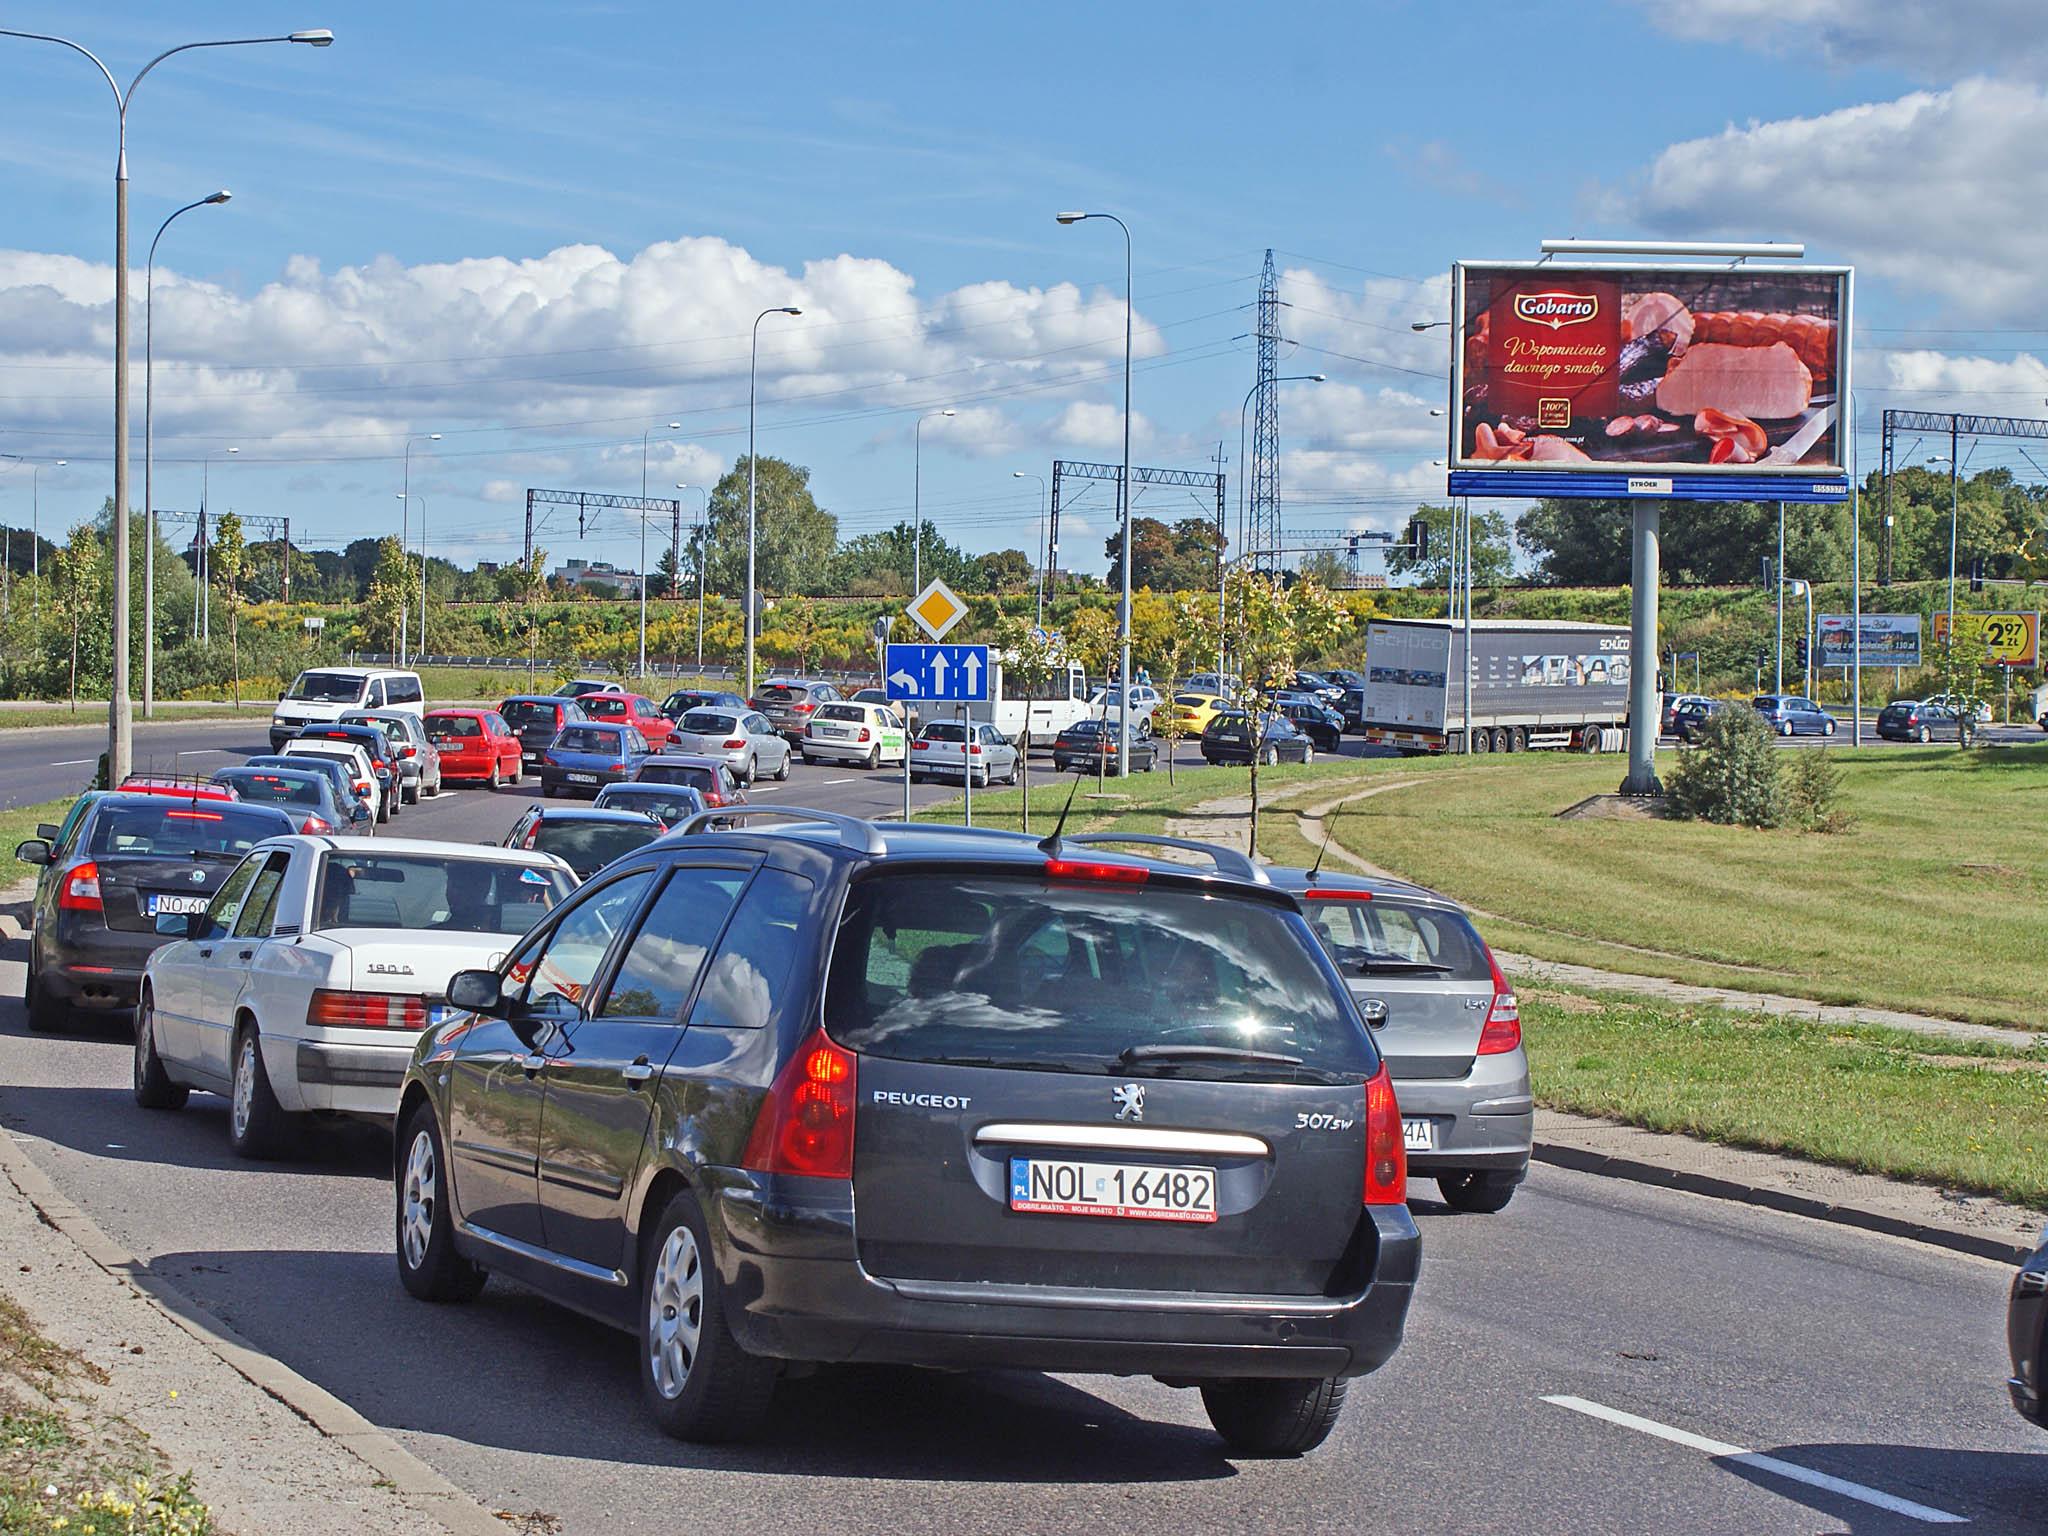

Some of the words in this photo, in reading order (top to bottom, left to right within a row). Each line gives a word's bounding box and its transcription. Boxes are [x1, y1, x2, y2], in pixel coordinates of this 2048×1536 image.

[1520, 298, 1592, 314] Gobarto
[1503, 336, 1607, 361] Wspomnienie
[1503, 359, 1562, 380] dawnego
[1564, 361, 1606, 376] smaku
[160, 896, 183, 912] NO
[367, 963, 397, 974] 190
[873, 1090, 972, 1110] PEUGEOT
[1403, 1121, 1428, 1142] 4A
[1032, 1164, 1098, 1203] NOL
[1113, 1169, 1211, 1210] 16482
